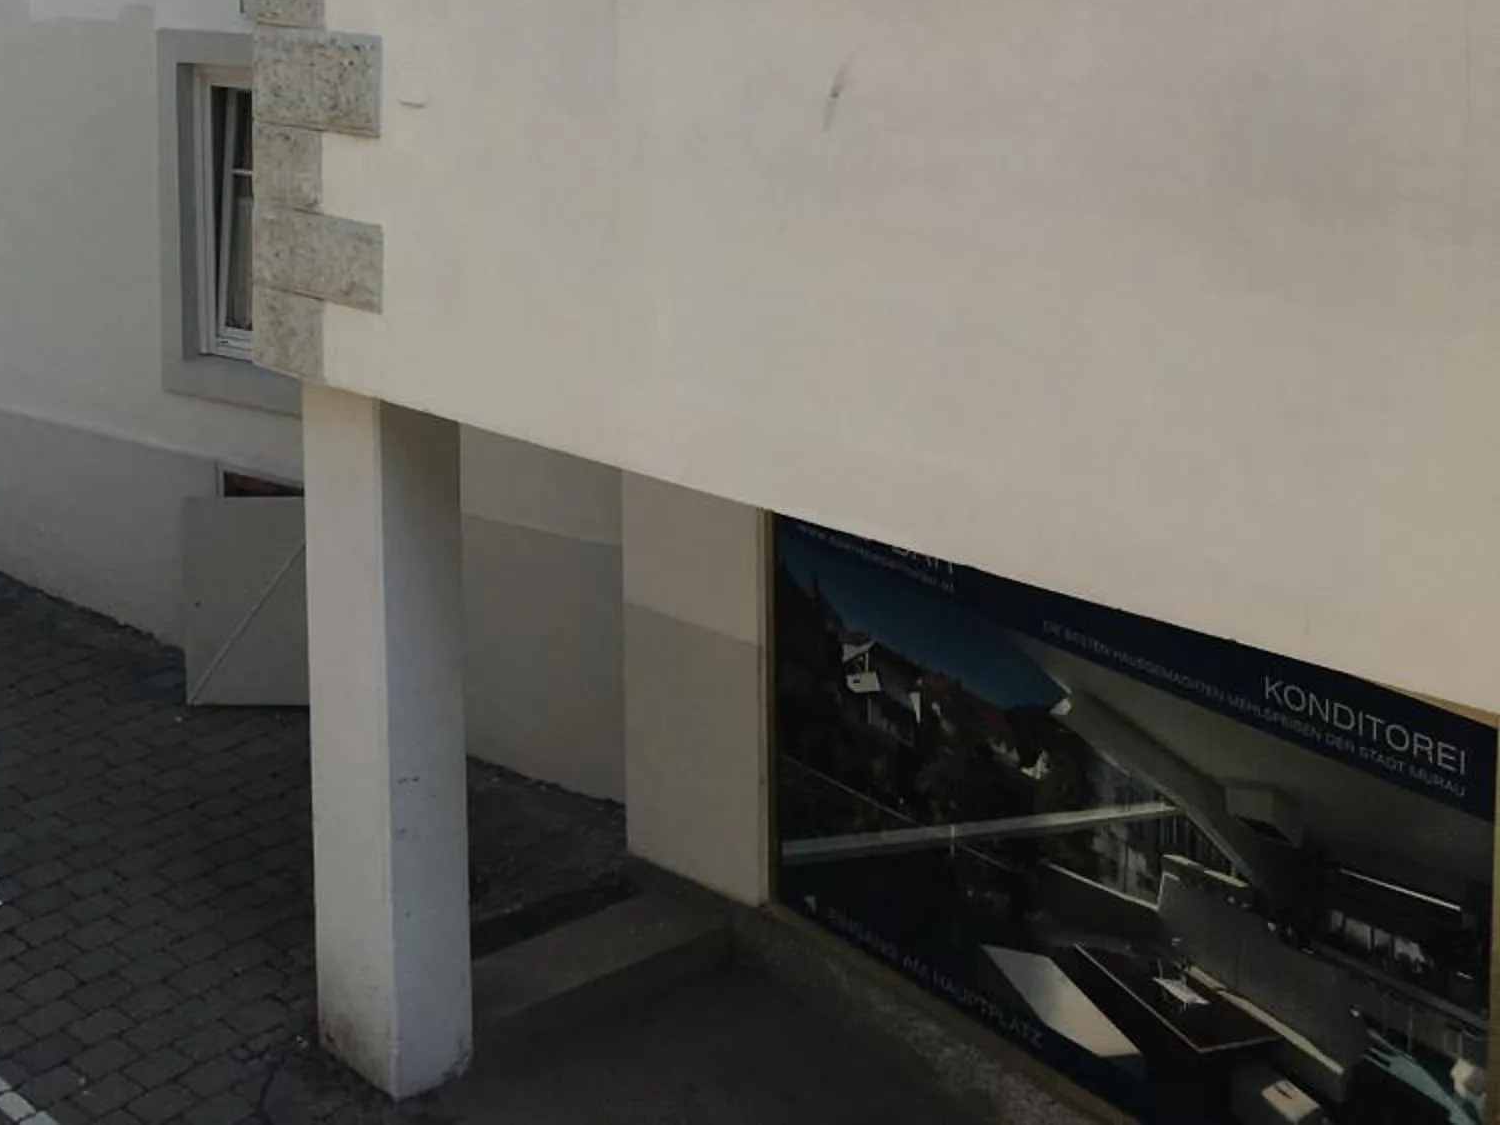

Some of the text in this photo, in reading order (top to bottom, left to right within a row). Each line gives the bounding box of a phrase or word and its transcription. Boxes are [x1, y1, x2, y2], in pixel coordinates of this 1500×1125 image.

[1265, 675, 1466, 776] KONDITOREI
[1326, 731, 1356, 755] DER
[1359, 746, 1405, 774] STADT
[1409, 763, 1466, 798] MURAU
